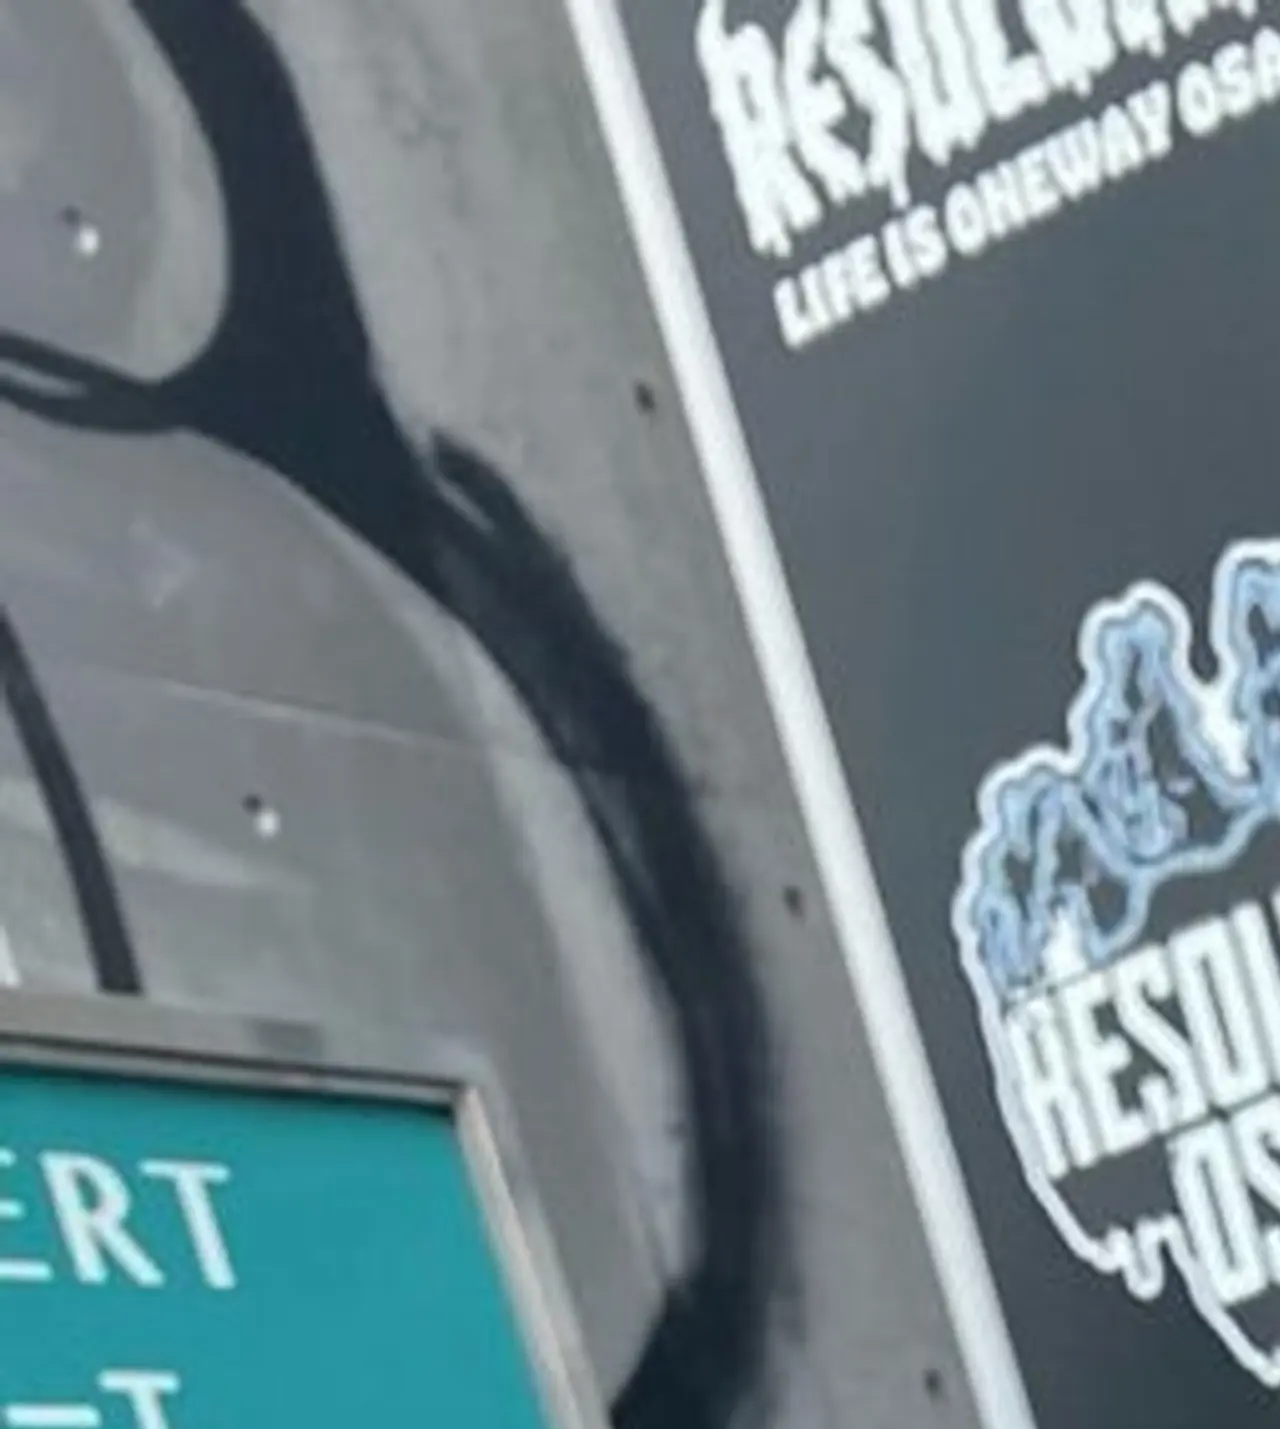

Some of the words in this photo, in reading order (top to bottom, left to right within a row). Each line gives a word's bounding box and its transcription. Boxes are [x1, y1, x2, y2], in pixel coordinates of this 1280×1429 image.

[774, 230, 891, 349] LIFE
[880, 205, 948, 291] IS
[944, 80, 1174, 257] ONEWAY
